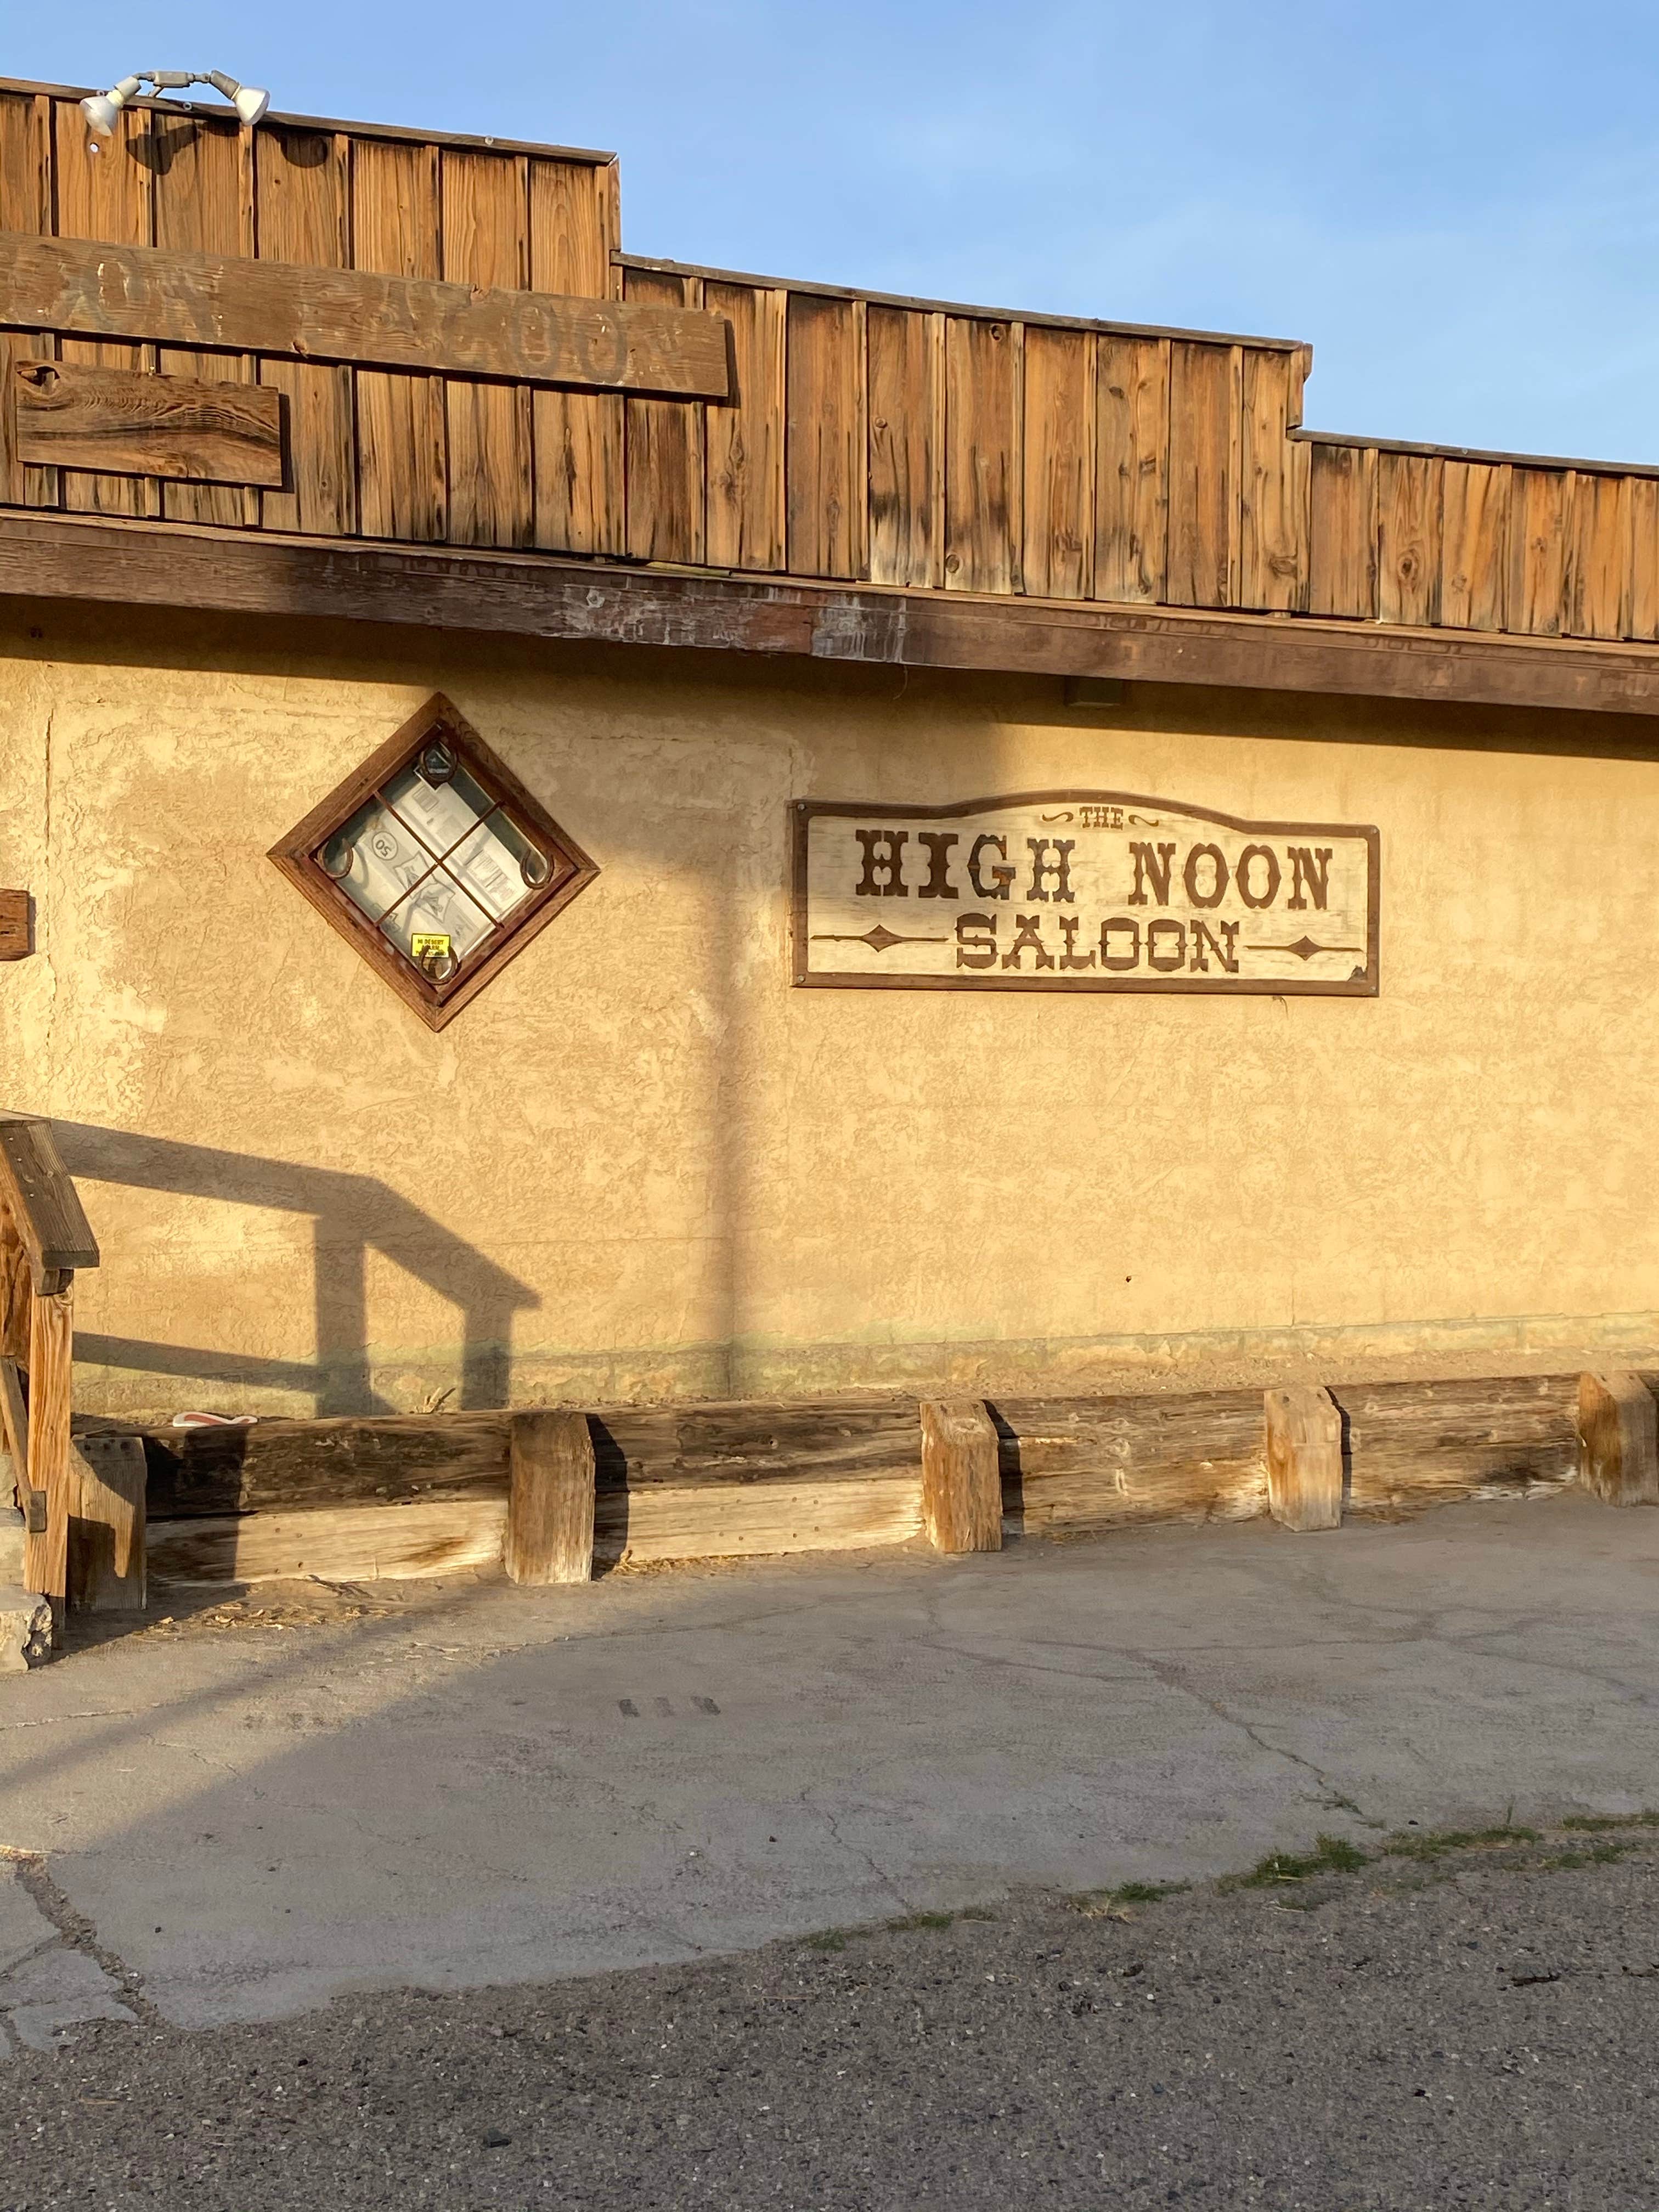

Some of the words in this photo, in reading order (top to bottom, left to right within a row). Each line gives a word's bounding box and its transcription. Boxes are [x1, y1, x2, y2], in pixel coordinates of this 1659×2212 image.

[1079, 806, 1124, 831] THE
[855, 829, 1075, 903] HIGH
[1128, 842, 1333, 910] NOON
[954, 912, 1239, 973] SALOON
